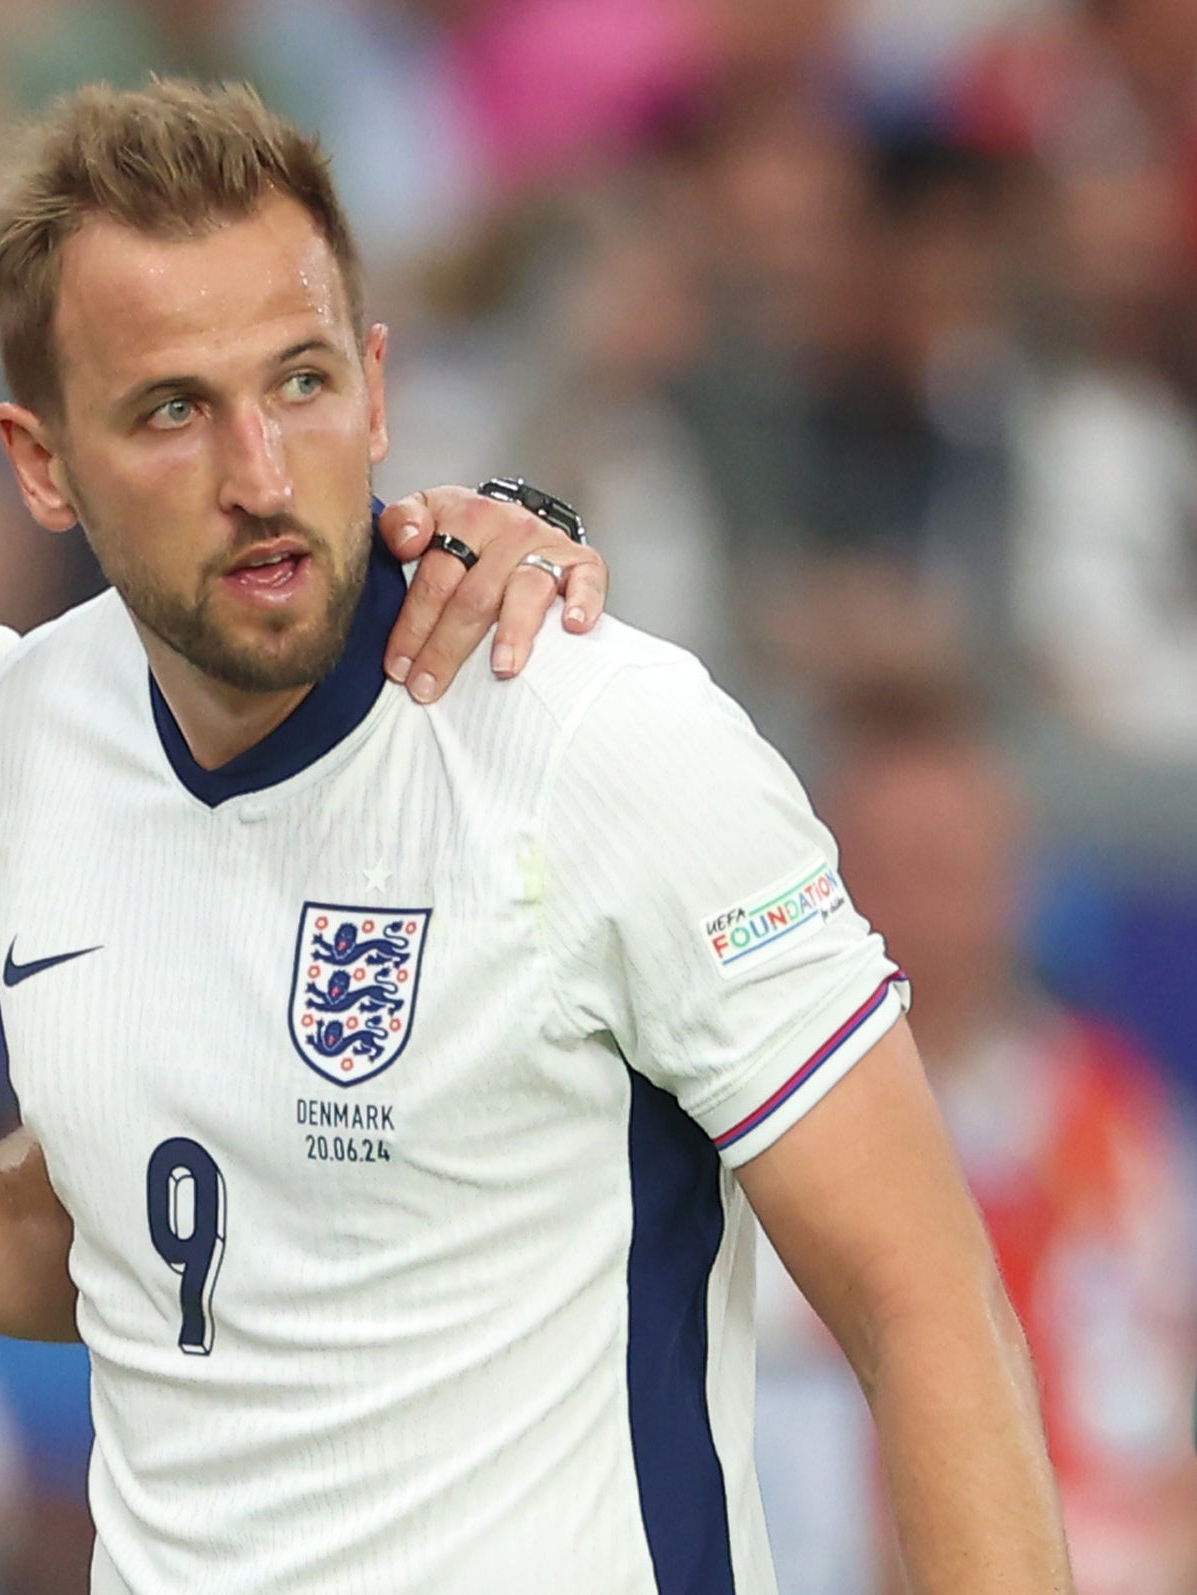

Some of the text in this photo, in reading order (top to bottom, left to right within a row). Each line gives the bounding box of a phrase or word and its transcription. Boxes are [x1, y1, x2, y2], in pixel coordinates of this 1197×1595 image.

[706, 908, 746, 935] UEFA
[297, 1099, 395, 1131] DENMARK
[305, 1135, 390, 1162] 20.06.24
[147, 1137, 227, 1356] 9
